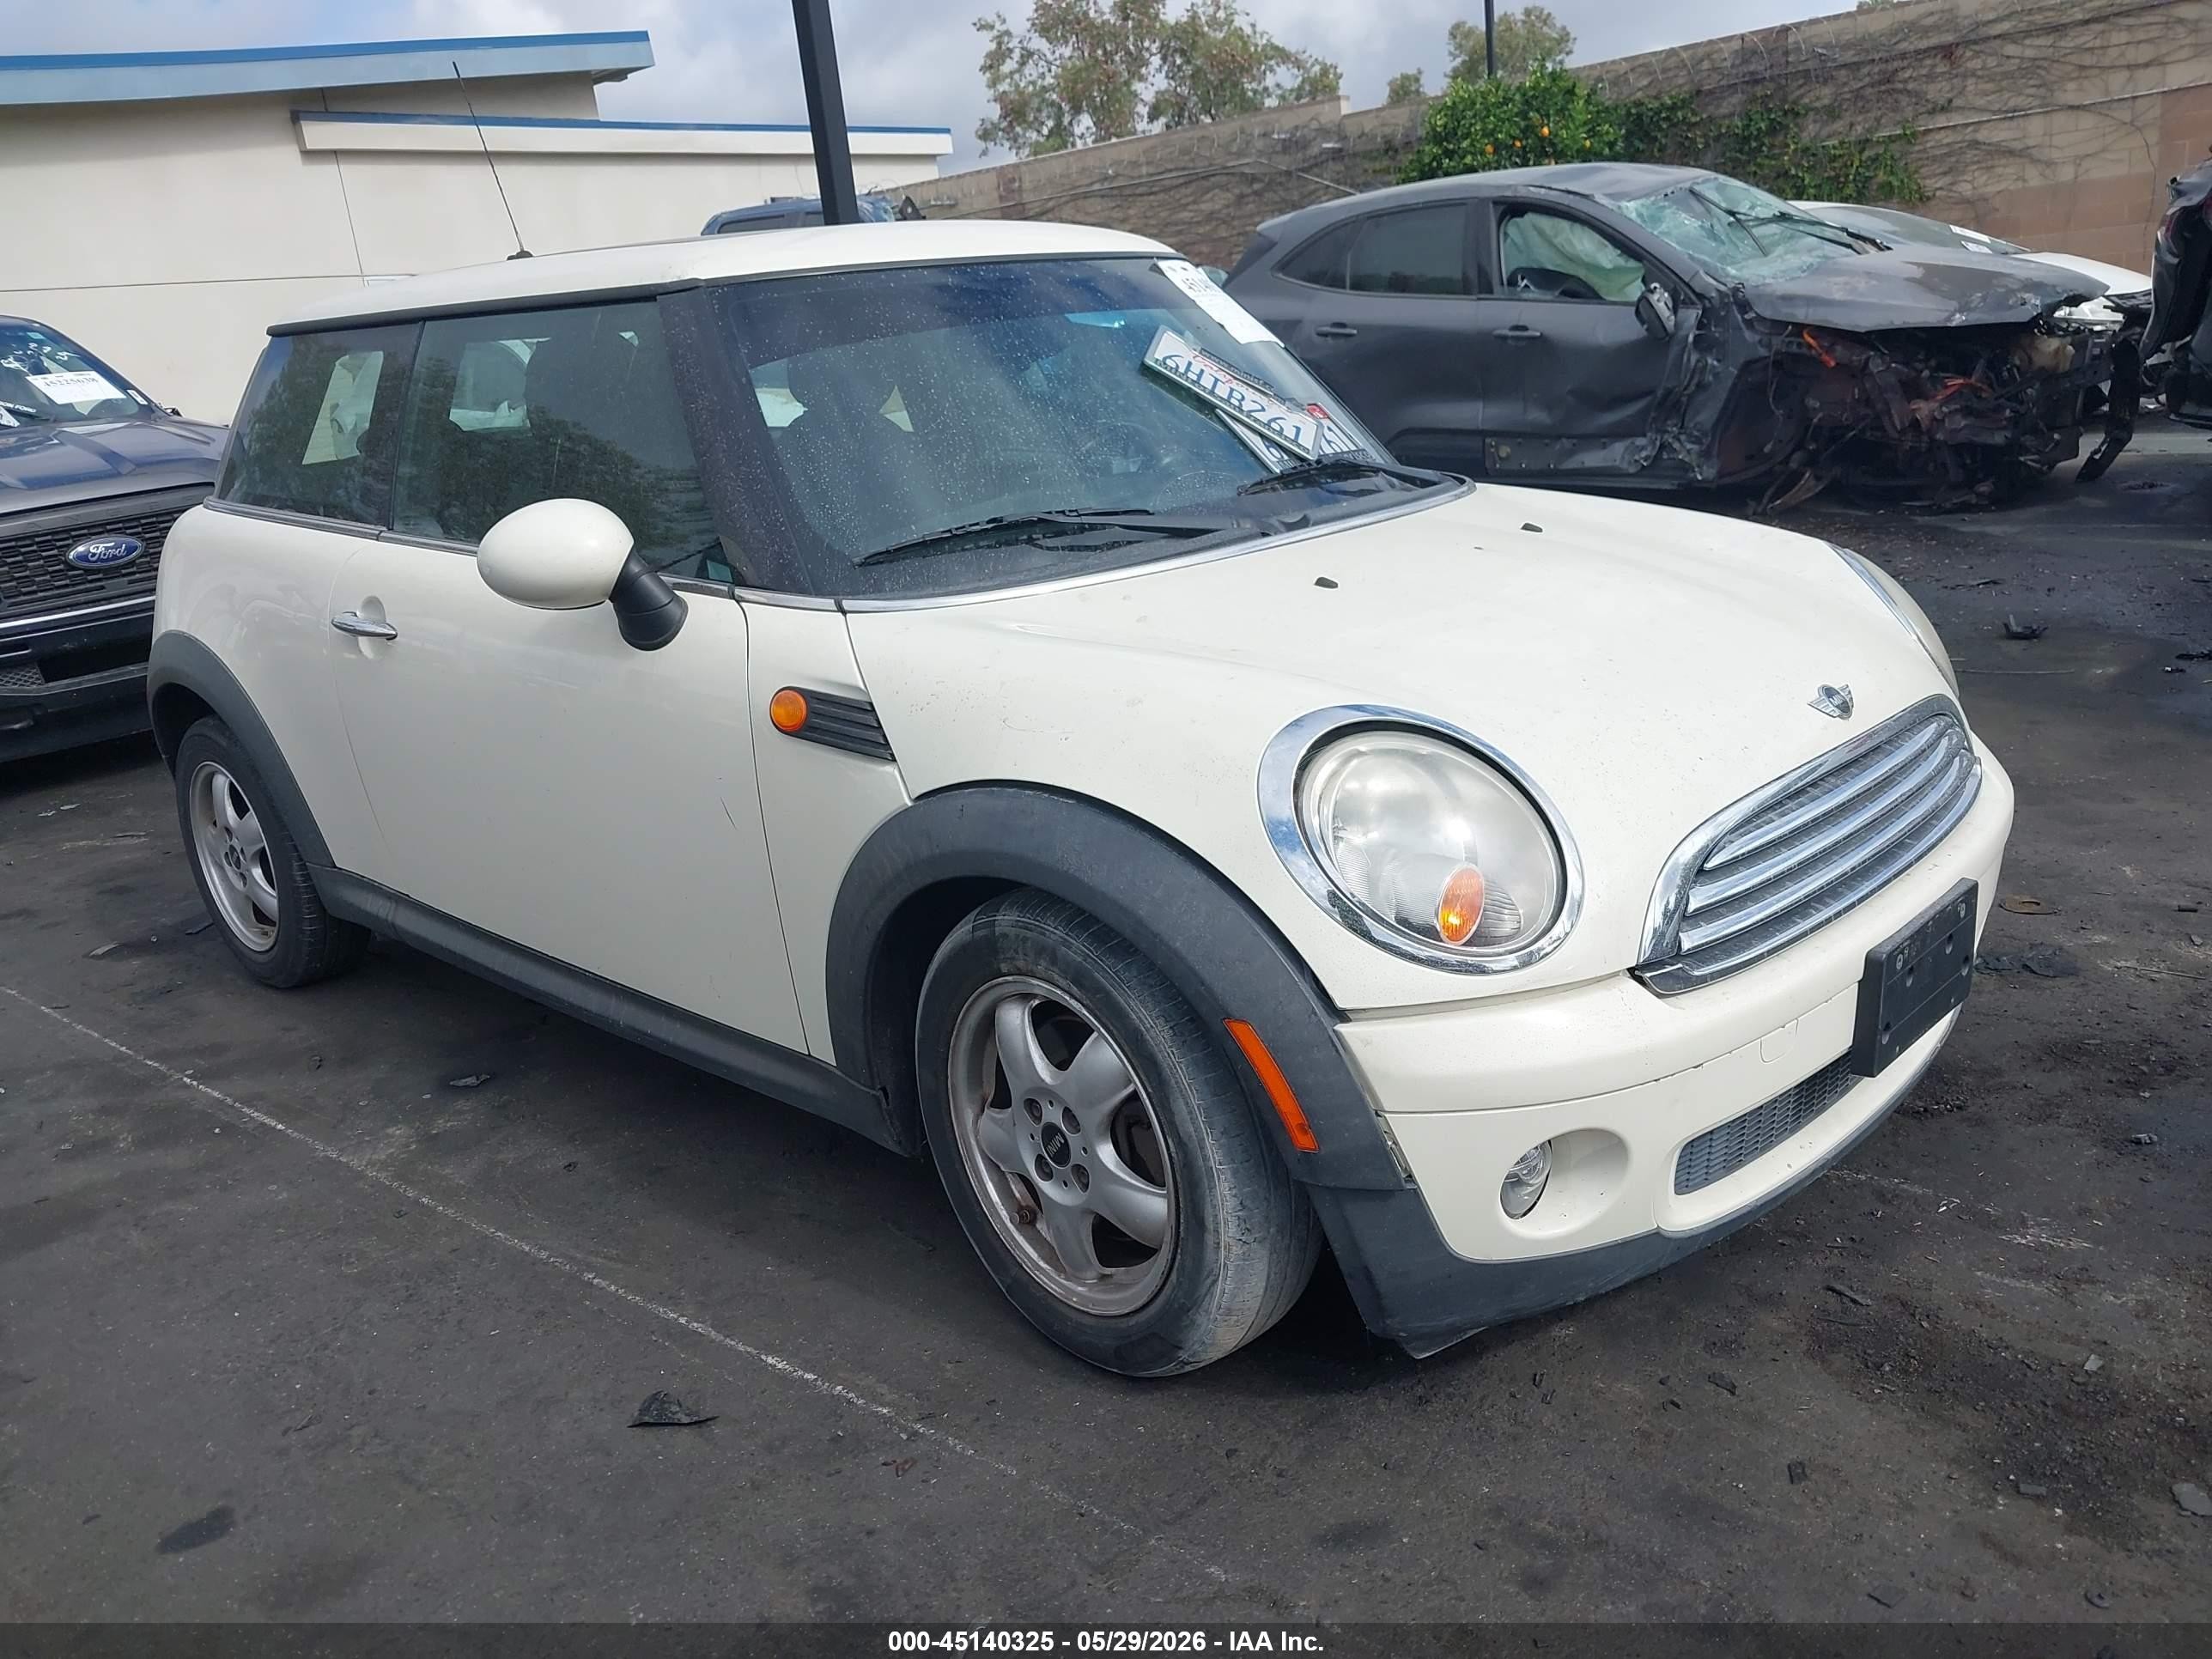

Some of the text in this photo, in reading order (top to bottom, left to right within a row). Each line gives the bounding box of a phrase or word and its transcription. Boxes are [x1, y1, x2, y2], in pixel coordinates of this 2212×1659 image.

[1162, 354, 1301, 442] 6HTB261
[88, 542, 126, 561] Ford
[1046, 1133, 1065, 1158] MINI
